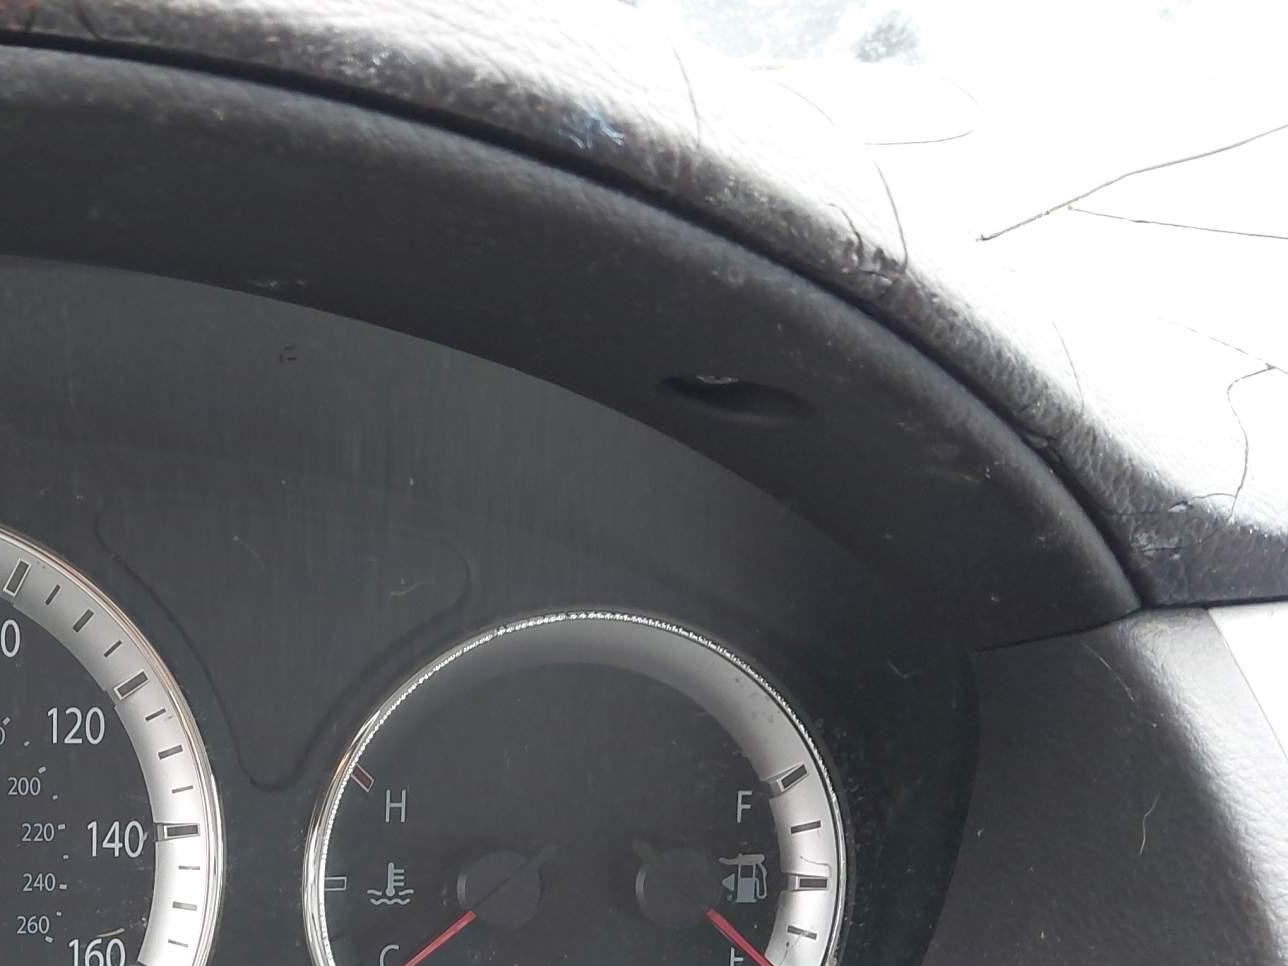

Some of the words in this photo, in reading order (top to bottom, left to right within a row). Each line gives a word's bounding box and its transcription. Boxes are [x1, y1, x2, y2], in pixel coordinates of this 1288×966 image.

[48, 707, 104, 744] 120
[8, 777, 40, 795] 200
[386, 790, 405, 822] H
[737, 791, 752, 823] F
[22, 823, 54, 841] 220
[88, 821, 143, 856] 140
[24, 873, 55, 891] 240
[17, 916, 49, 933] 260
